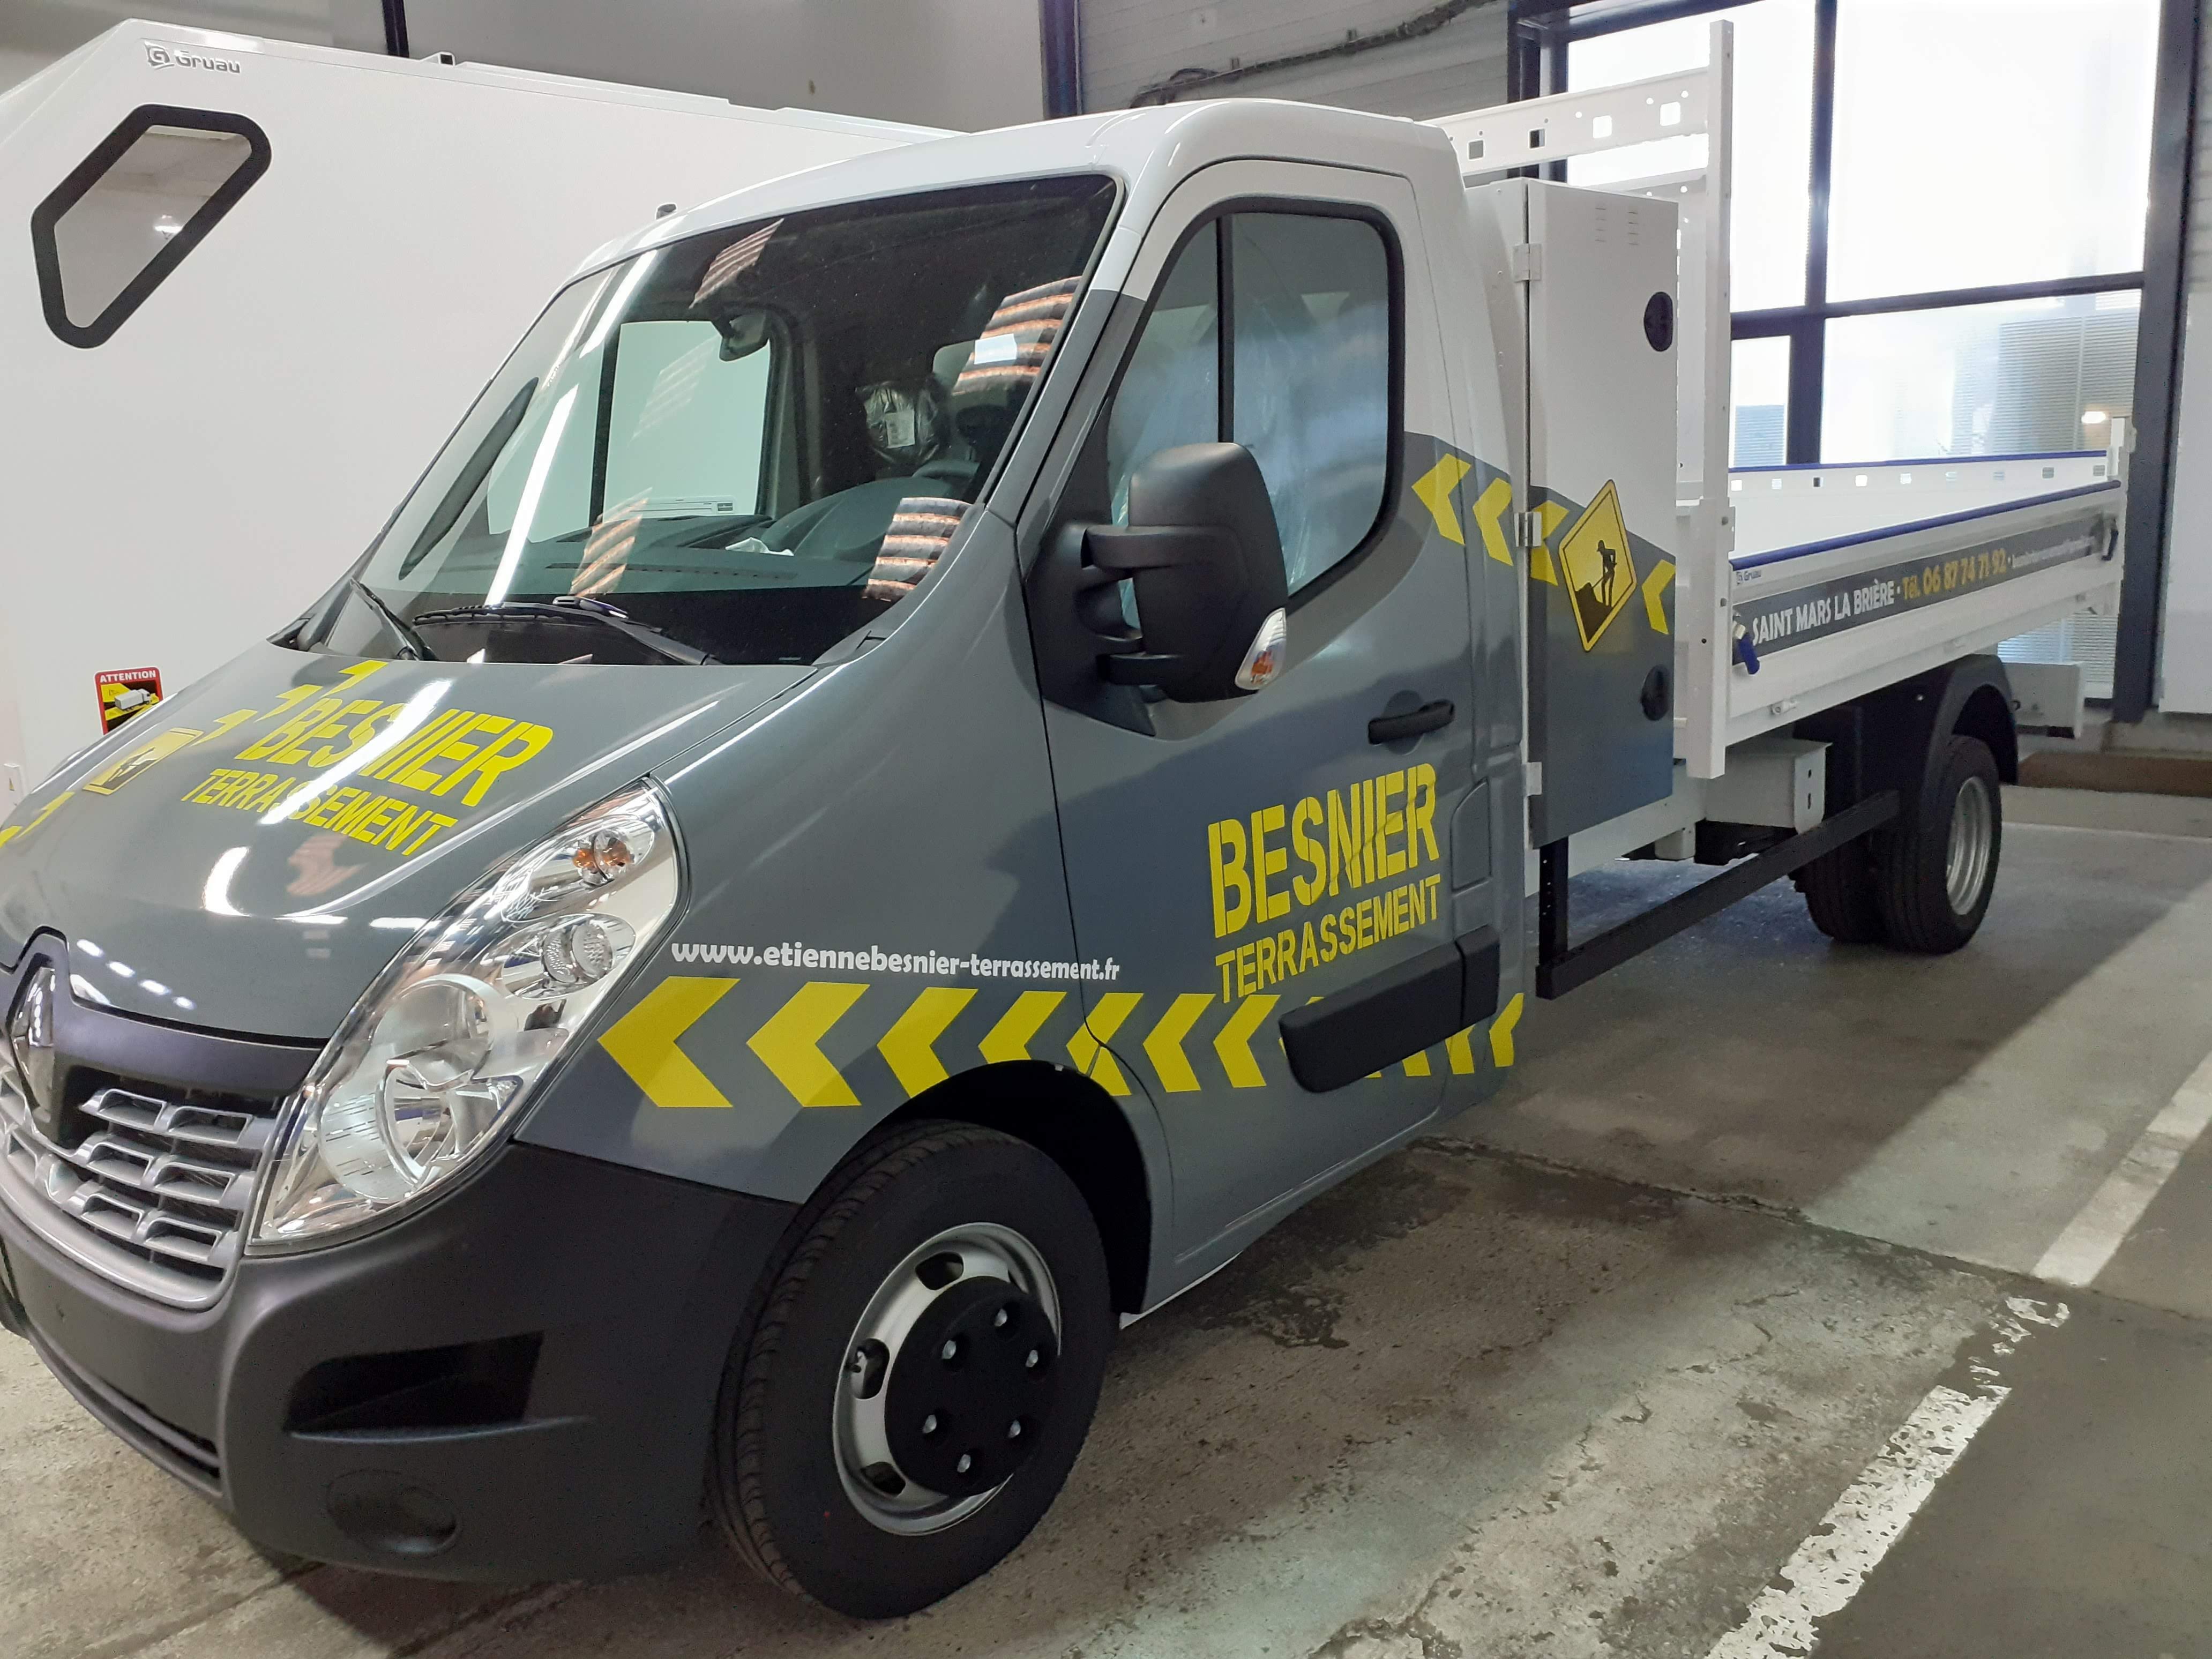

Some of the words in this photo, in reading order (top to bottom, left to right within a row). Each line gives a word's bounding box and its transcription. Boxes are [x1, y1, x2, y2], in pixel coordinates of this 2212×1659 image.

[174, 50, 241, 74] Gruau
[1752, 608, 1793, 646] SAINT
[1796, 597, 1831, 632] MARS
[1834, 592, 1851, 621] LA
[1854, 579, 1895, 615] BRIÈRE
[1923, 565, 1941, 595] 06
[100, 670, 156, 683] ATTENTION
[1207, 763, 1440, 939] BESNIER
[671, 941, 1120, 981] www.etiennebesnier-terrassement.fr
[1215, 873, 1441, 1004] TERRASSEMENT
